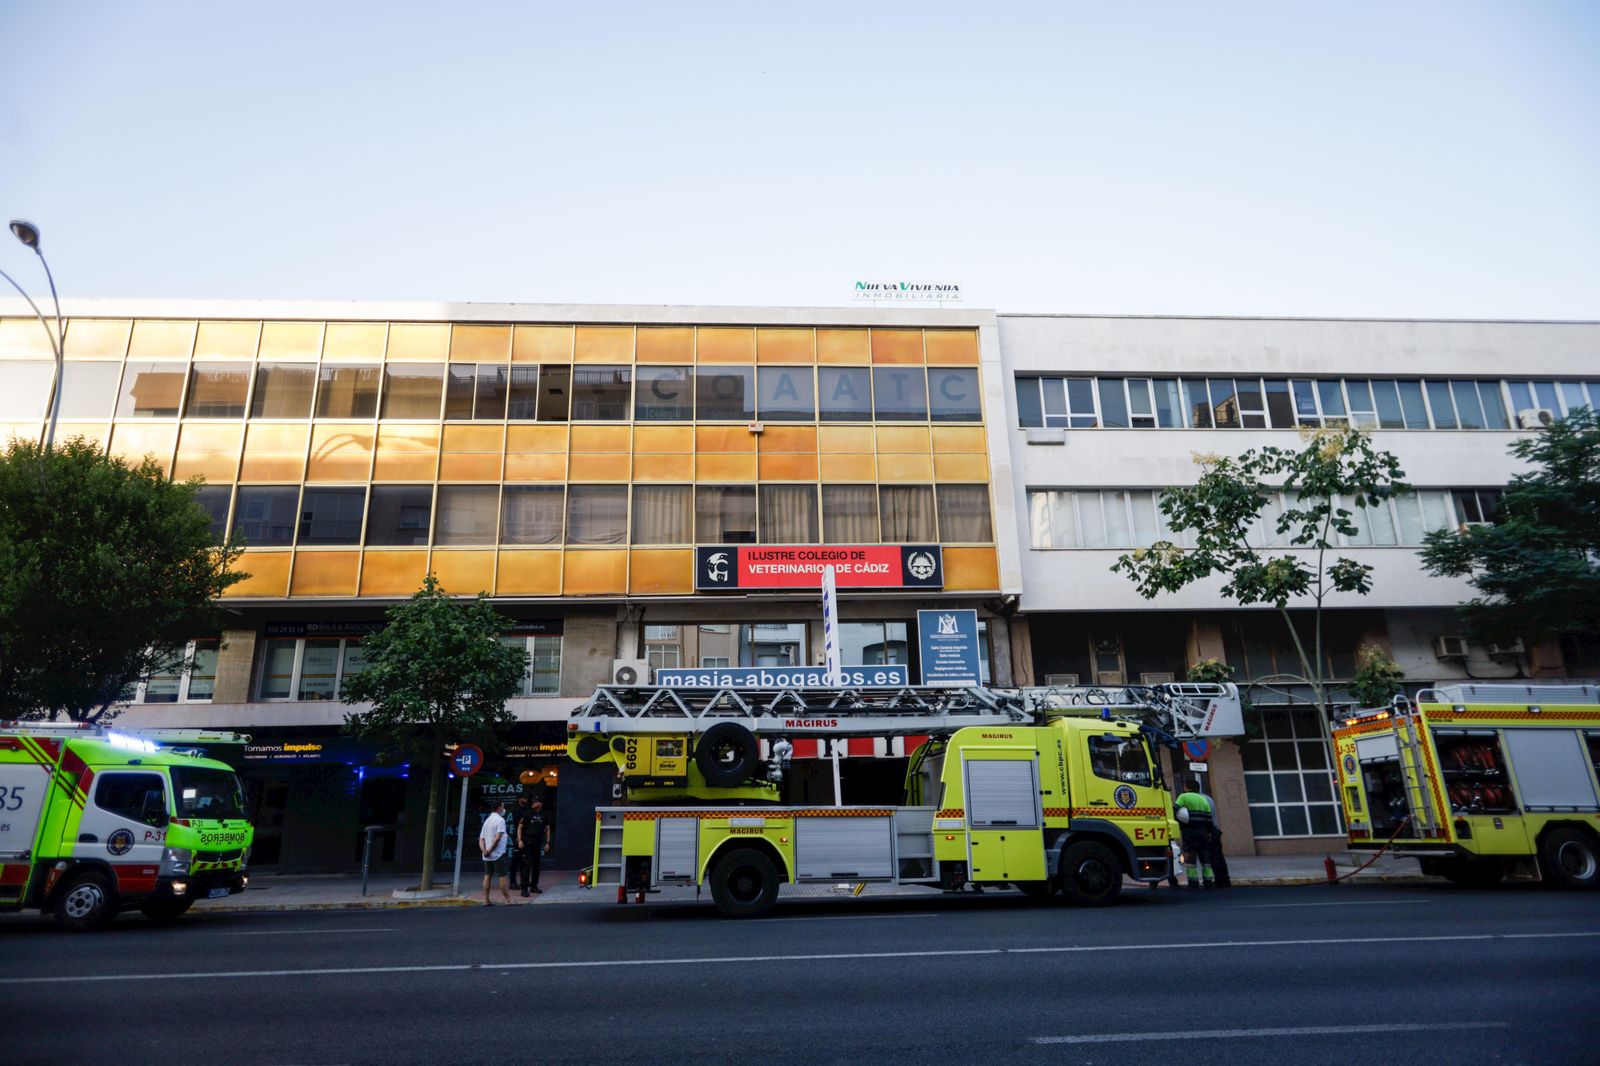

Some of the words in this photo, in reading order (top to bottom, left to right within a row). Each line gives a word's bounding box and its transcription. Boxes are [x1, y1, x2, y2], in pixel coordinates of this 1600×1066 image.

[856, 292, 960, 300] INMOBILIARIA
[747, 551, 798, 561] ILUSTRE
[799, 551, 848, 561] COLEGIO
[850, 551, 866, 560] DE
[836, 564, 852, 573] DE
[854, 562, 889, 573] CÁDIZ
[785, 719, 838, 728] MAGIRUS
[1204, 704, 1218, 732] MAGIRUS
[243, 744, 282, 752] Tomamos
[283, 742, 322, 753] impulso
[539, 742, 568, 752] impuls
[1336, 743, 1356, 755] U-35
[626, 738, 638, 770] 6602
[1056, 739, 1066, 796] www.cbpc.es
[481, 783, 524, 794] TECAS
[191, 820, 204, 828] P-31
[144, 831, 166, 841] P-31
[1135, 827, 1166, 841] E-17
